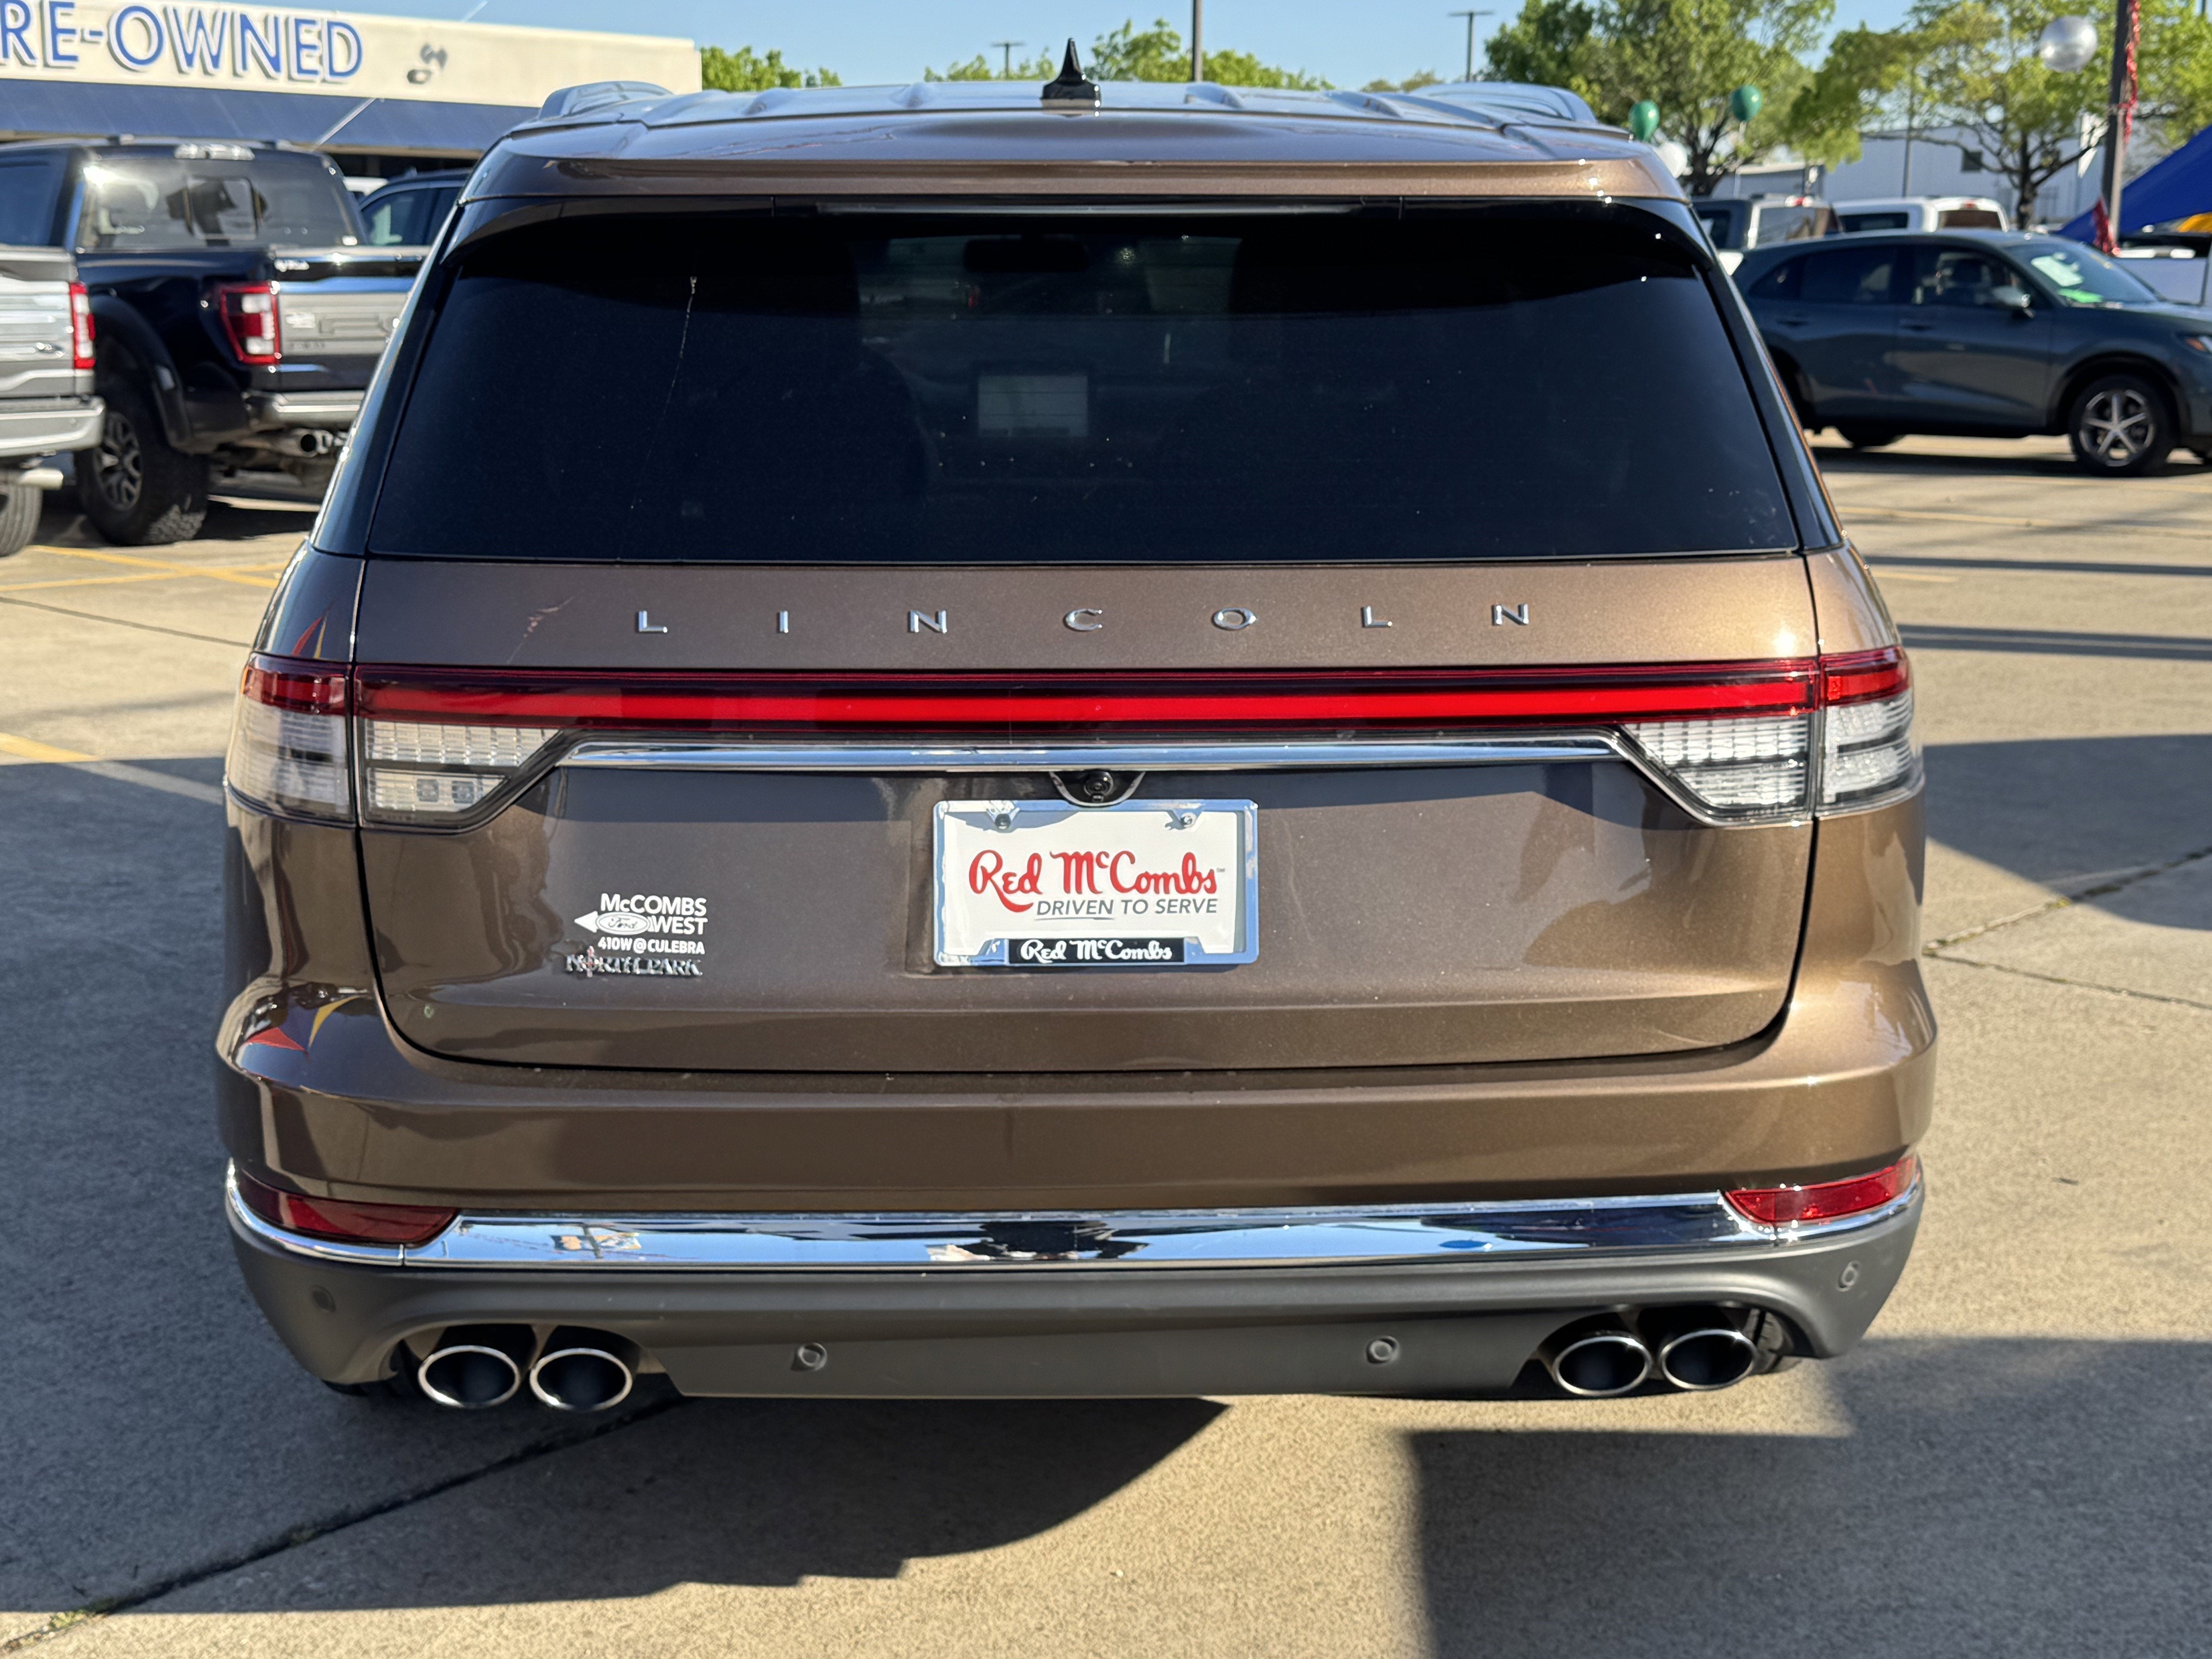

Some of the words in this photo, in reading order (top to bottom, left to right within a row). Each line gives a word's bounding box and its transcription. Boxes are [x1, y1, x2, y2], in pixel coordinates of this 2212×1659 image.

[635, 603, 1530, 632] LINCOLN
[969, 850, 1042, 912] Red
[1050, 850, 1217, 894] McCombs
[601, 893, 707, 916] McCOMBS
[1037, 900, 1113, 915] DRIVEN
[1121, 899, 1148, 914] TO
[1155, 898, 1218, 914] SERVE
[608, 916, 638, 929] Ford
[651, 915, 708, 935] WEST
[1021, 940, 1066, 963] Red
[1070, 940, 1172, 960] McCombs
